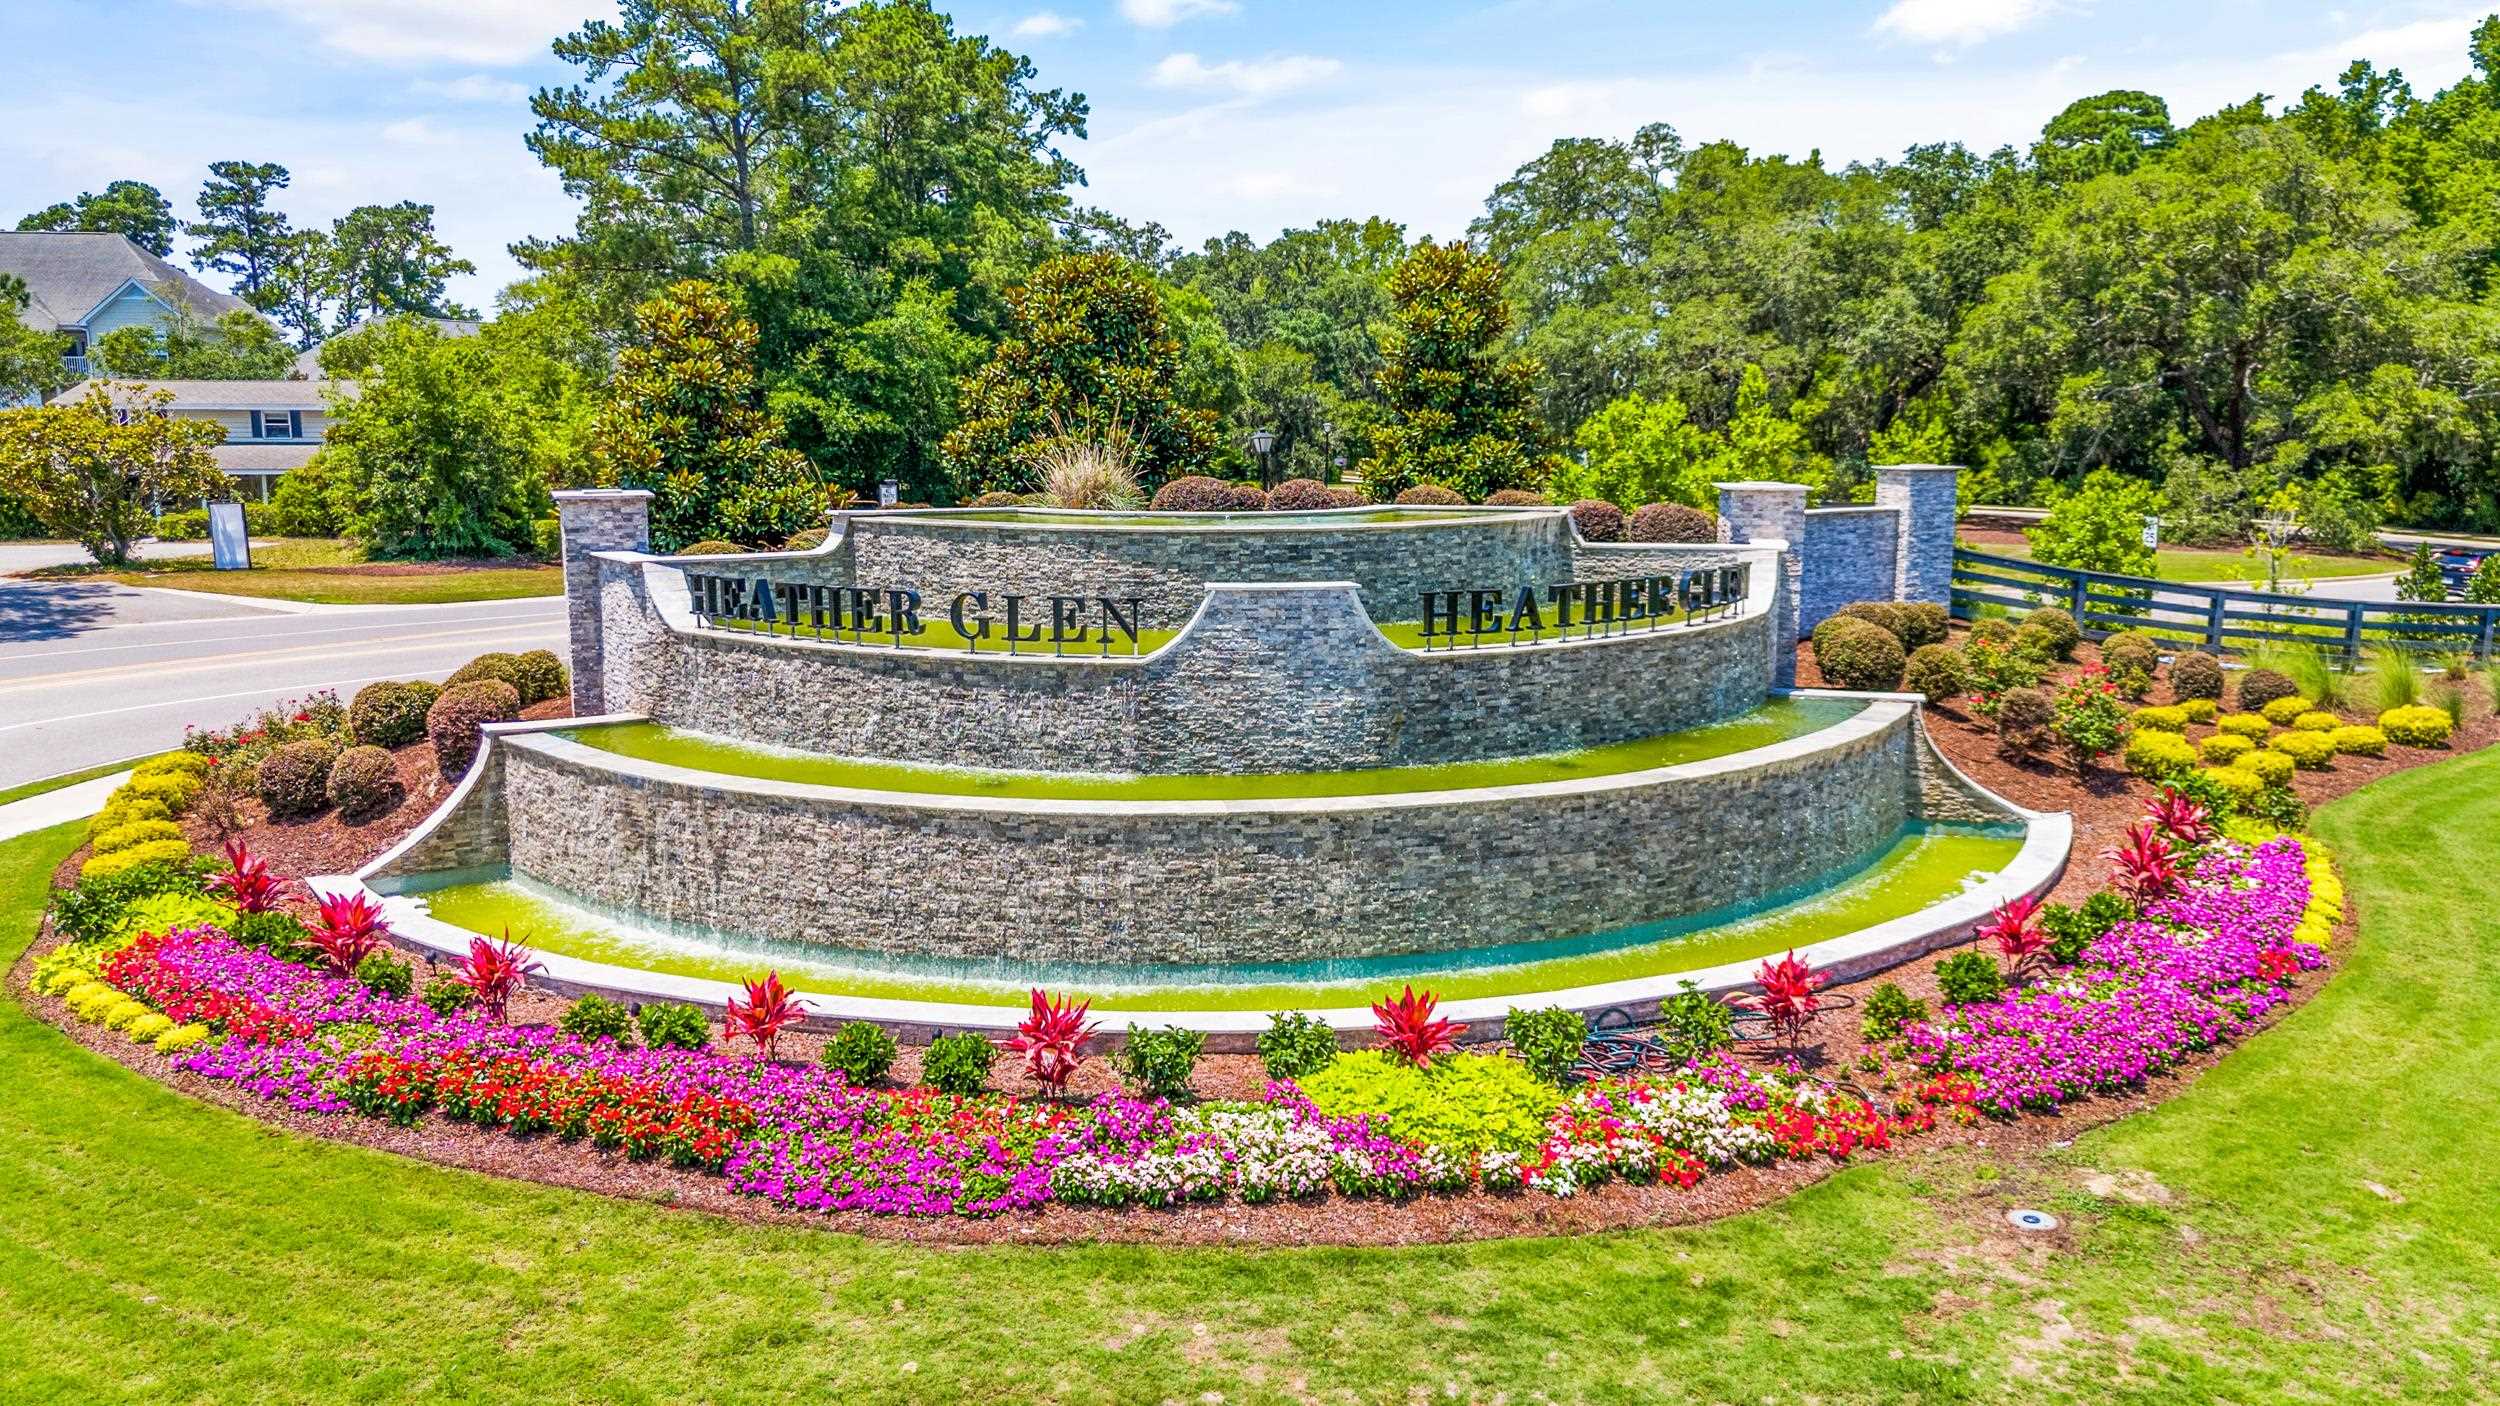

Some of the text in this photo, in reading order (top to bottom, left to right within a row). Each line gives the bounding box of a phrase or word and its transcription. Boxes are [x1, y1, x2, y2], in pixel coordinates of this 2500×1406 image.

[688, 574, 1143, 643] HEATHER GLEN
[1418, 575, 1675, 636] HEATHER
